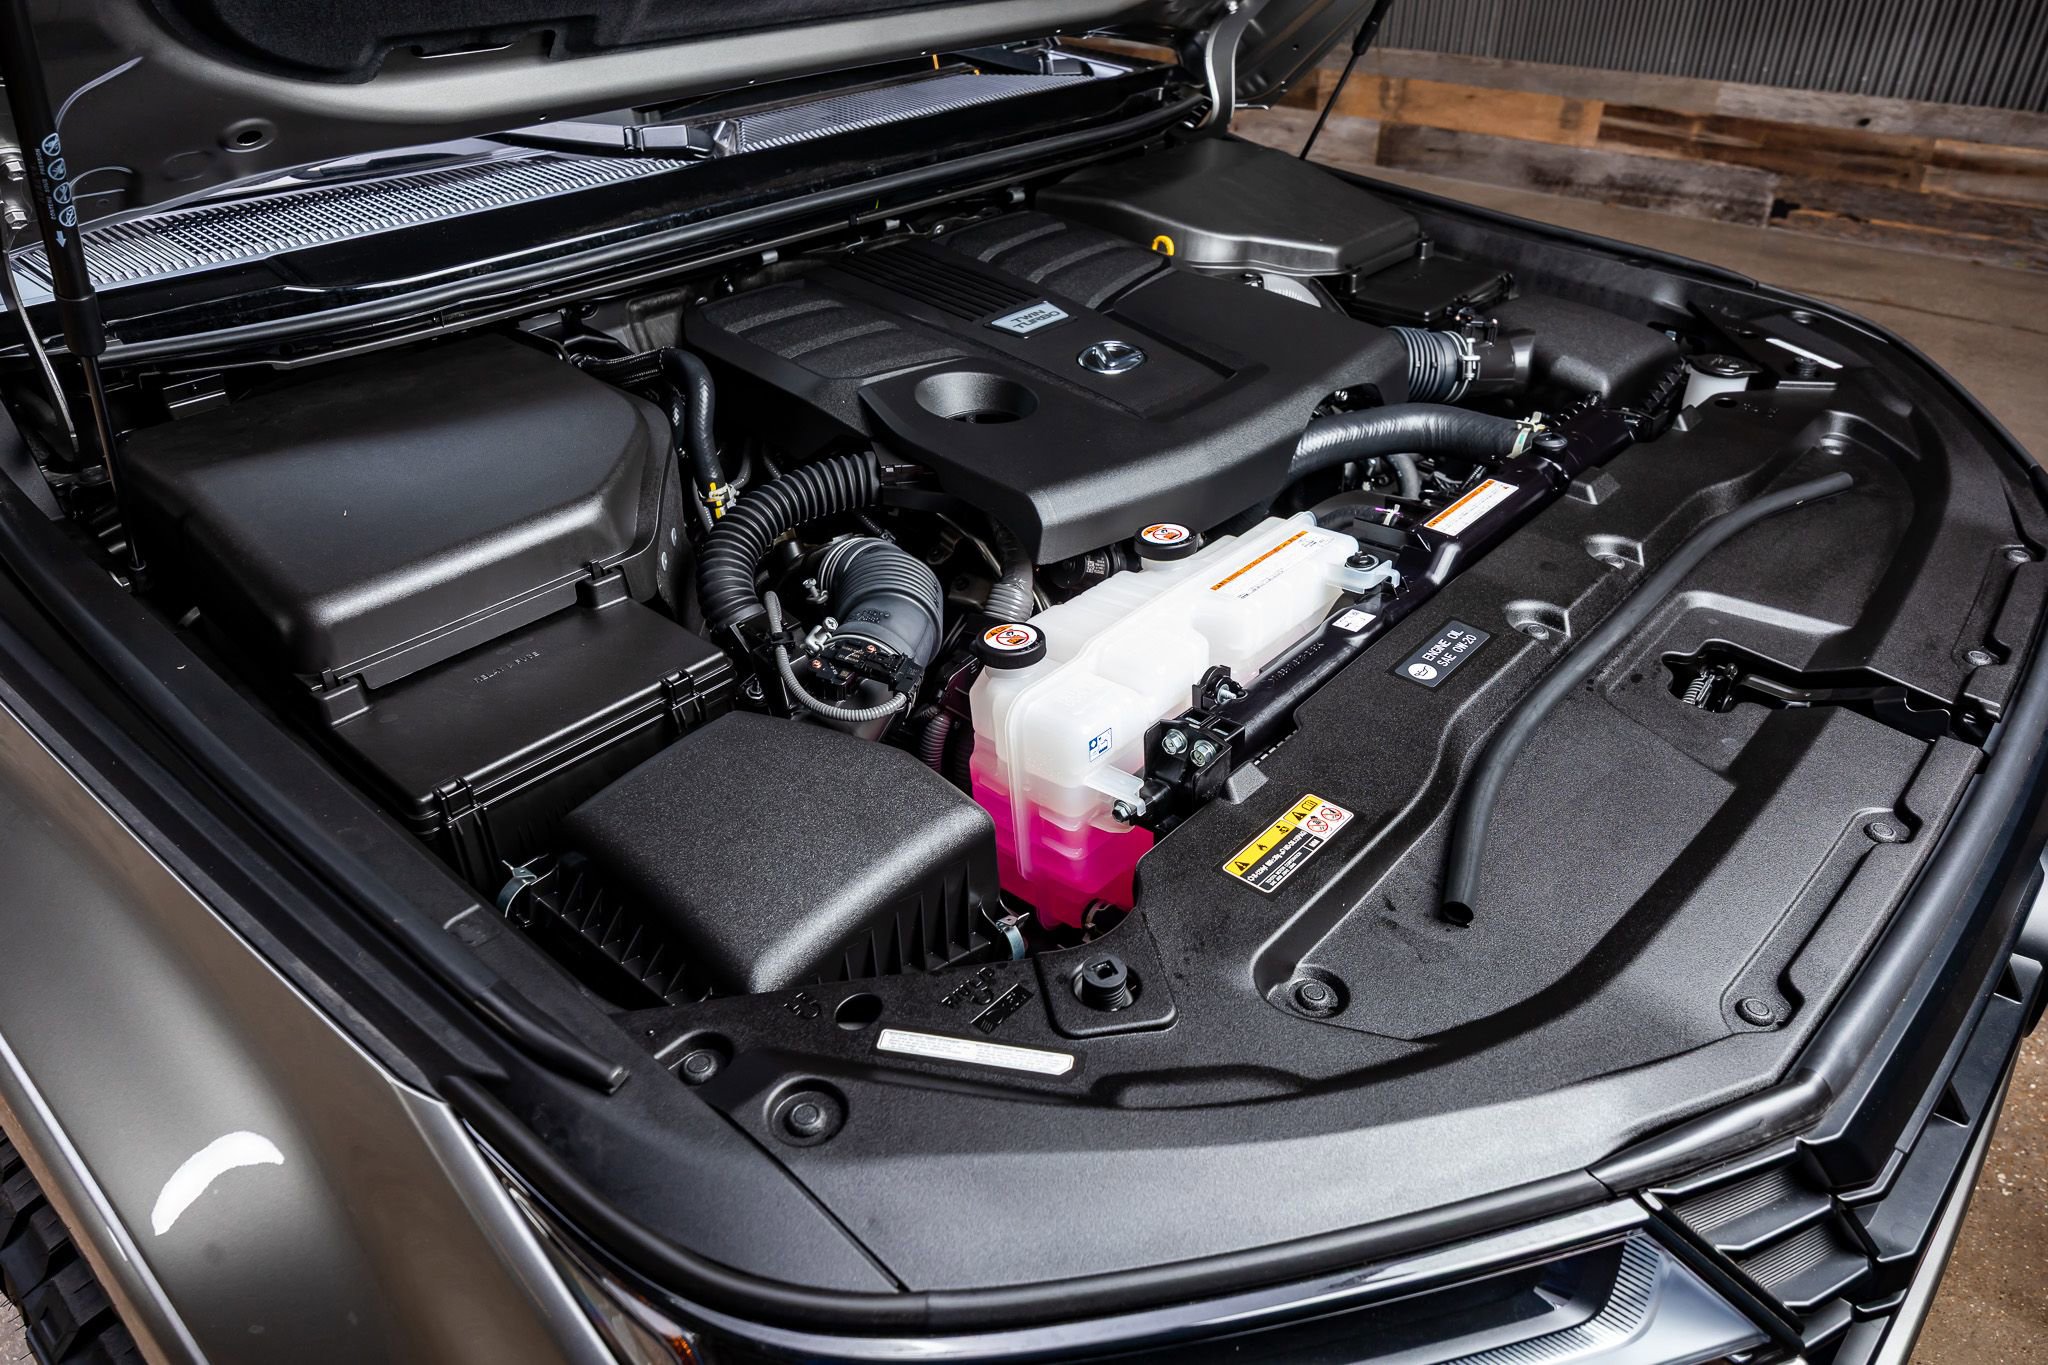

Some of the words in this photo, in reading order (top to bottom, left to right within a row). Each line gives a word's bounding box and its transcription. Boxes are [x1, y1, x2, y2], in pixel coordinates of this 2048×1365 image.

[1011, 309, 1045, 323] TWIN
[1013, 311, 1060, 328] TURBO
[1422, 639, 1451, 661] ENGINE
[1447, 630, 1464, 640] OIL
[1437, 653, 1457, 667] SAE
[1452, 634, 1477, 653] 0W-20
